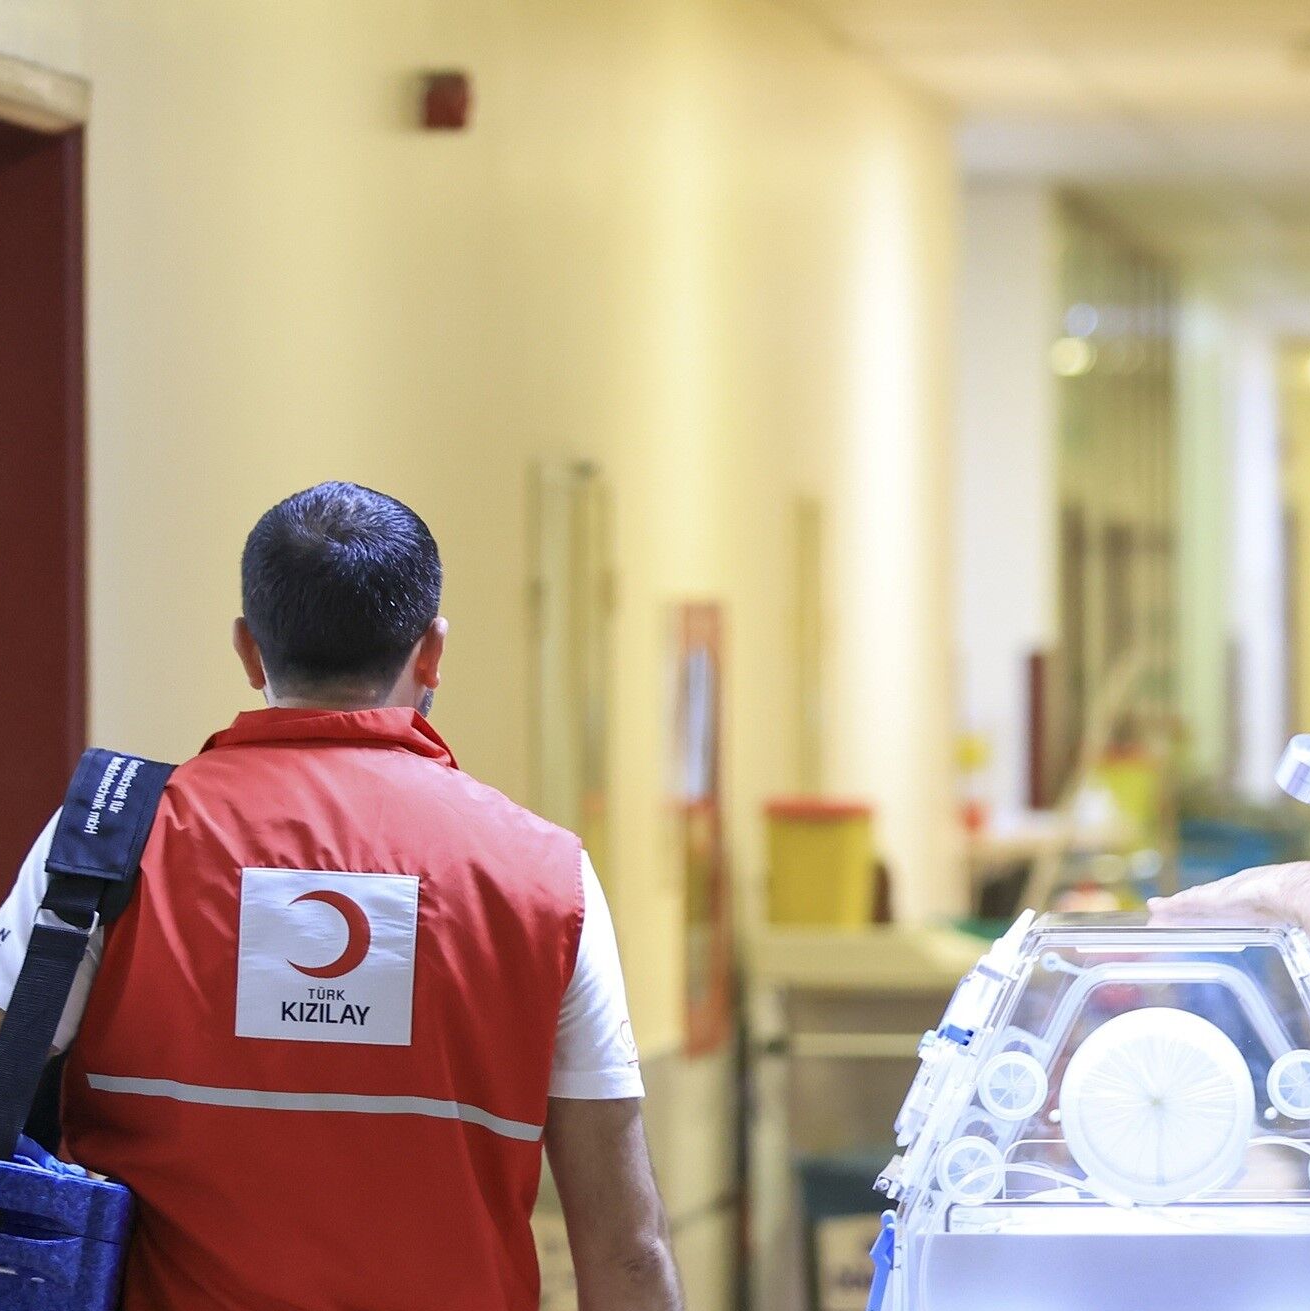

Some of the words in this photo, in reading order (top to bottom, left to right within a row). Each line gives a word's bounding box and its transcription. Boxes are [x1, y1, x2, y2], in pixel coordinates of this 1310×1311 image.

[84, 811, 100, 834] mbH
[308, 986, 346, 1001] TÜRK
[281, 1001, 370, 1026] KIZILAY
